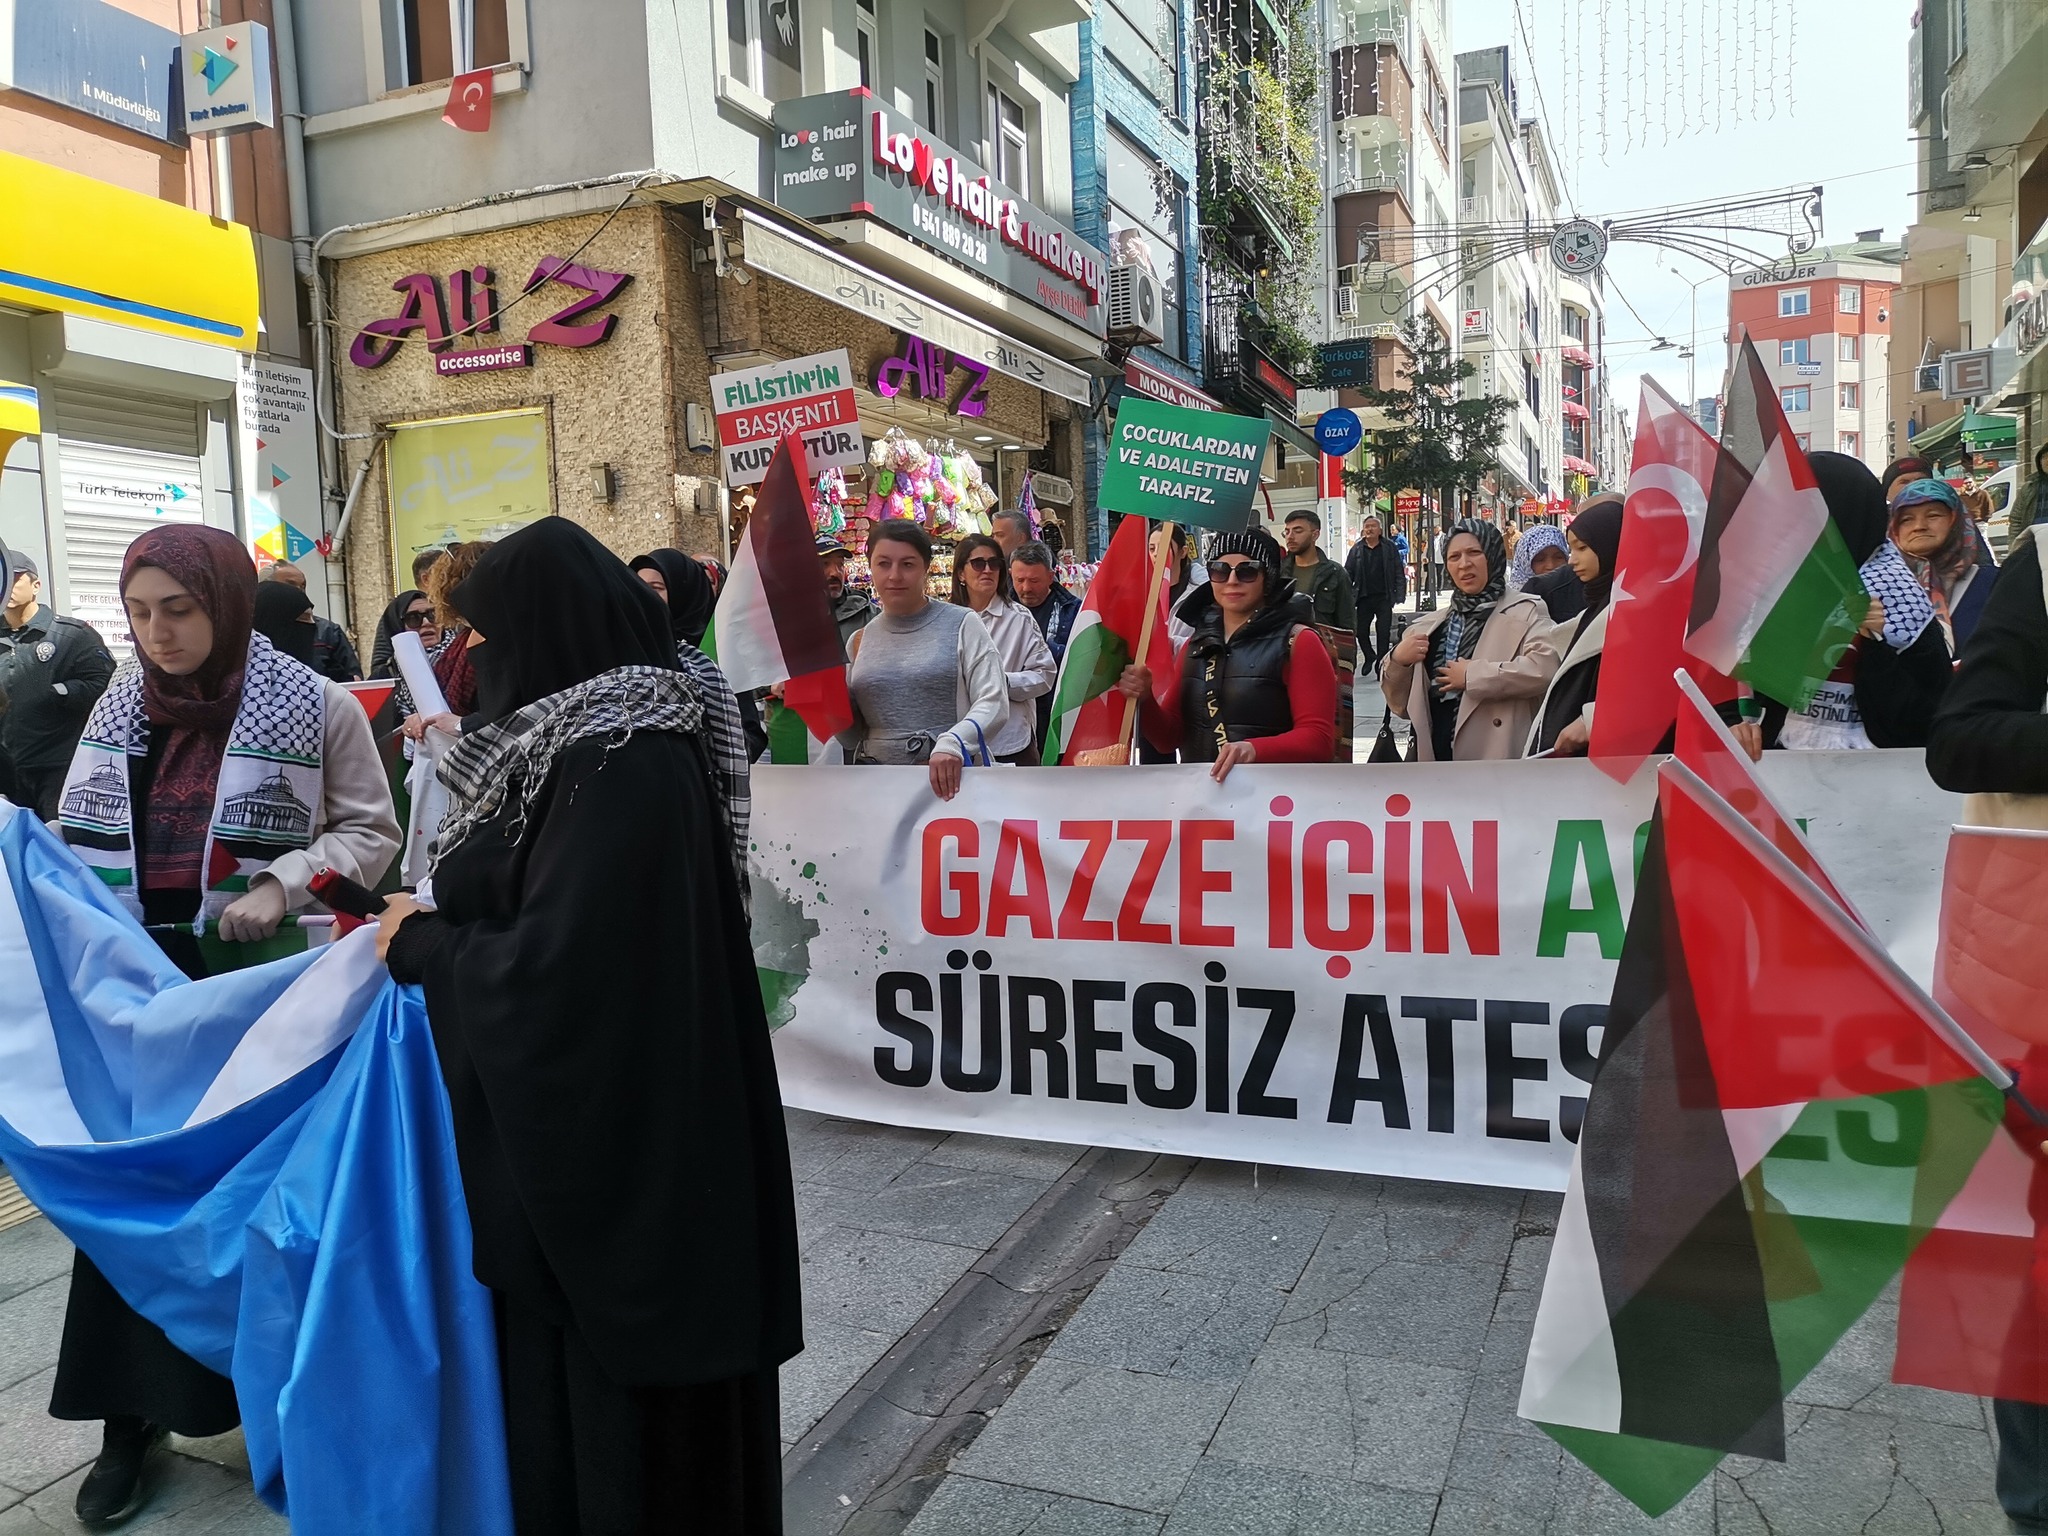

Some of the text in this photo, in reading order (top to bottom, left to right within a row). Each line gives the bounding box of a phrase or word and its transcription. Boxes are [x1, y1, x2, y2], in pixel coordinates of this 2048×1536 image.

[94, 87, 160, 123] Müdürlüğü
[823, 121, 857, 142] hair
[811, 147, 824, 163] &
[783, 160, 857, 186] make up
[947, 157, 1002, 230] hair
[1003, 199, 1024, 244] &
[913, 203, 987, 265] 0 541 889 20 28
[350, 255, 635, 369] Ali Z
[835, 280, 924, 330] Ali Z
[242, 366, 301, 385] Tüm iletişim
[439, 348, 522, 371] accessorise
[873, 334, 946, 398] Ali
[984, 345, 1046, 382] Ali Z
[242, 379, 310, 400] ihtiyaçlarınız,
[724, 364, 840, 407] FİLİSTİN'İN
[1139, 373, 1177, 403] MODA
[243, 394, 306, 413] çok avantajlı
[244, 406, 290, 422] fiyatlarla
[735, 395, 840, 438] BAŞKENTİ
[245, 420, 281, 434] burada
[1122, 423, 1257, 461] ÇOCUKLARDAN
[1325, 427, 1350, 438] ÖZAY
[1119, 447, 1250, 485] VE ADALETTEN
[78, 481, 166, 502] Türk Telekom
[1139, 475, 1215, 505] TARAFIZ.
[922, 817, 1234, 947] GAZZE
[1268, 794, 1499, 979] İÇİN
[874, 949, 1298, 1120] SÜRESİZ
